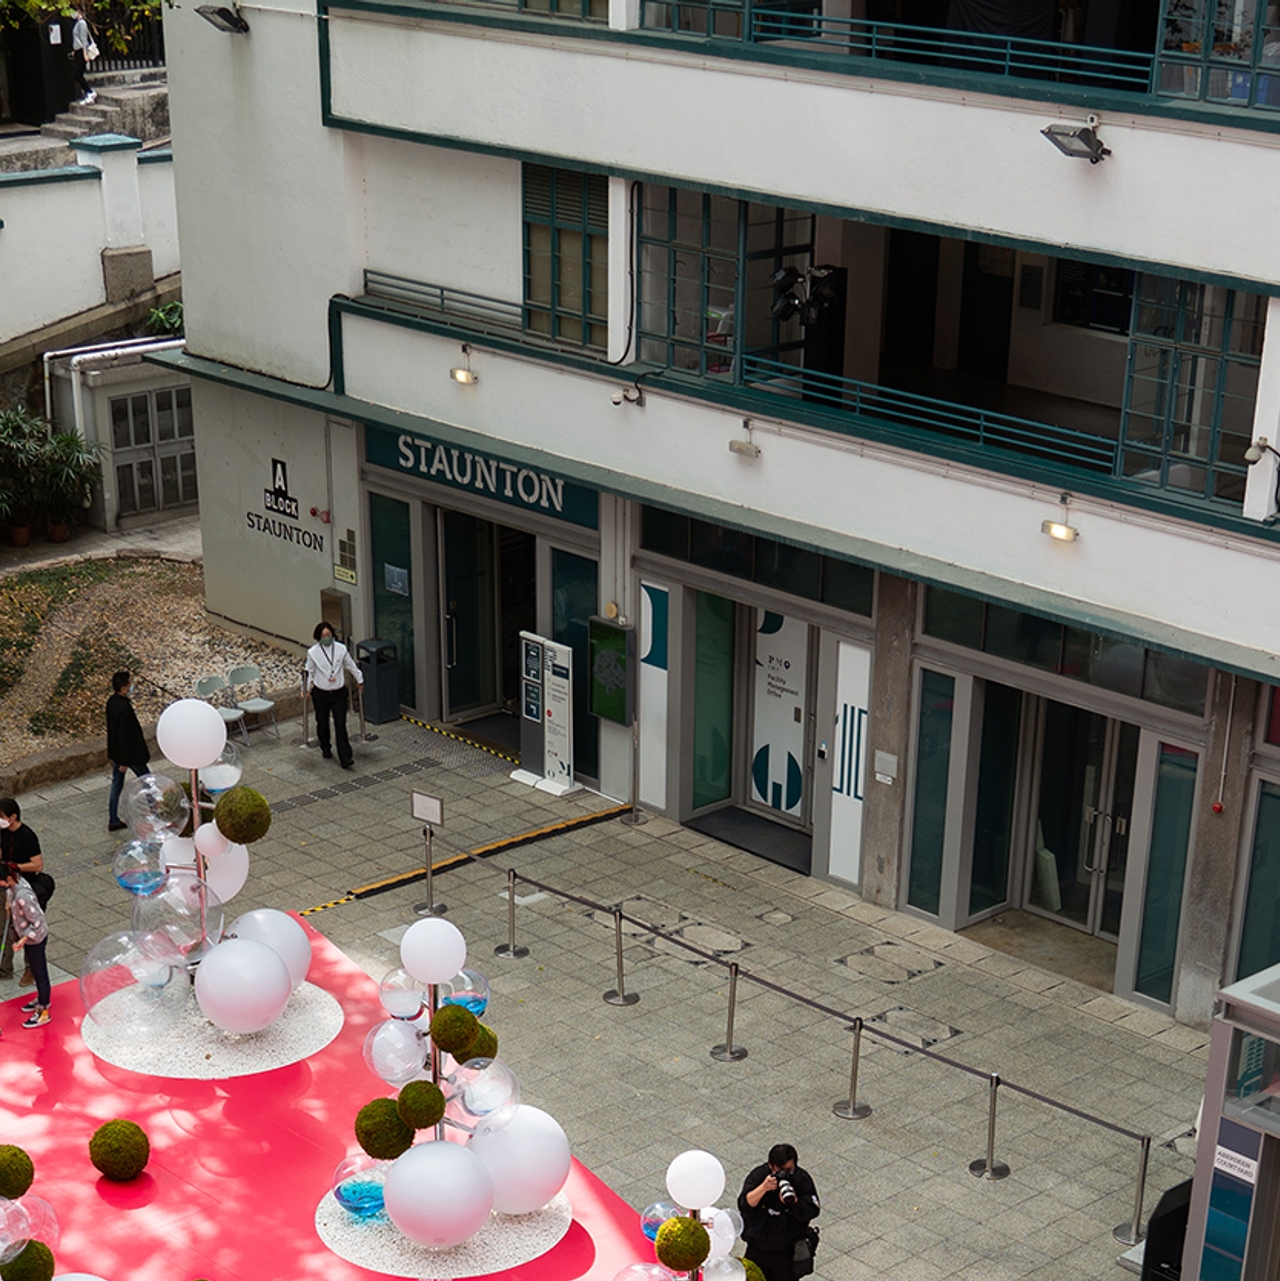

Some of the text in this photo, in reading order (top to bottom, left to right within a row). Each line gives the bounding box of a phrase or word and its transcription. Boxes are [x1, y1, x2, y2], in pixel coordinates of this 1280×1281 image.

[274, 463, 286, 491] A
[398, 434, 565, 512] STAUNTON
[264, 492, 299, 518] BLOCK
[246, 511, 324, 552] STAUNTON
[768, 655, 791, 670] PMQ
[767, 673, 787, 685] Facility
[767, 681, 799, 696] Management
[766, 688, 782, 698] Office
[1216, 1157, 1254, 1178] COURTYARD
[1217, 1150, 1251, 1168] ABERDEEN
